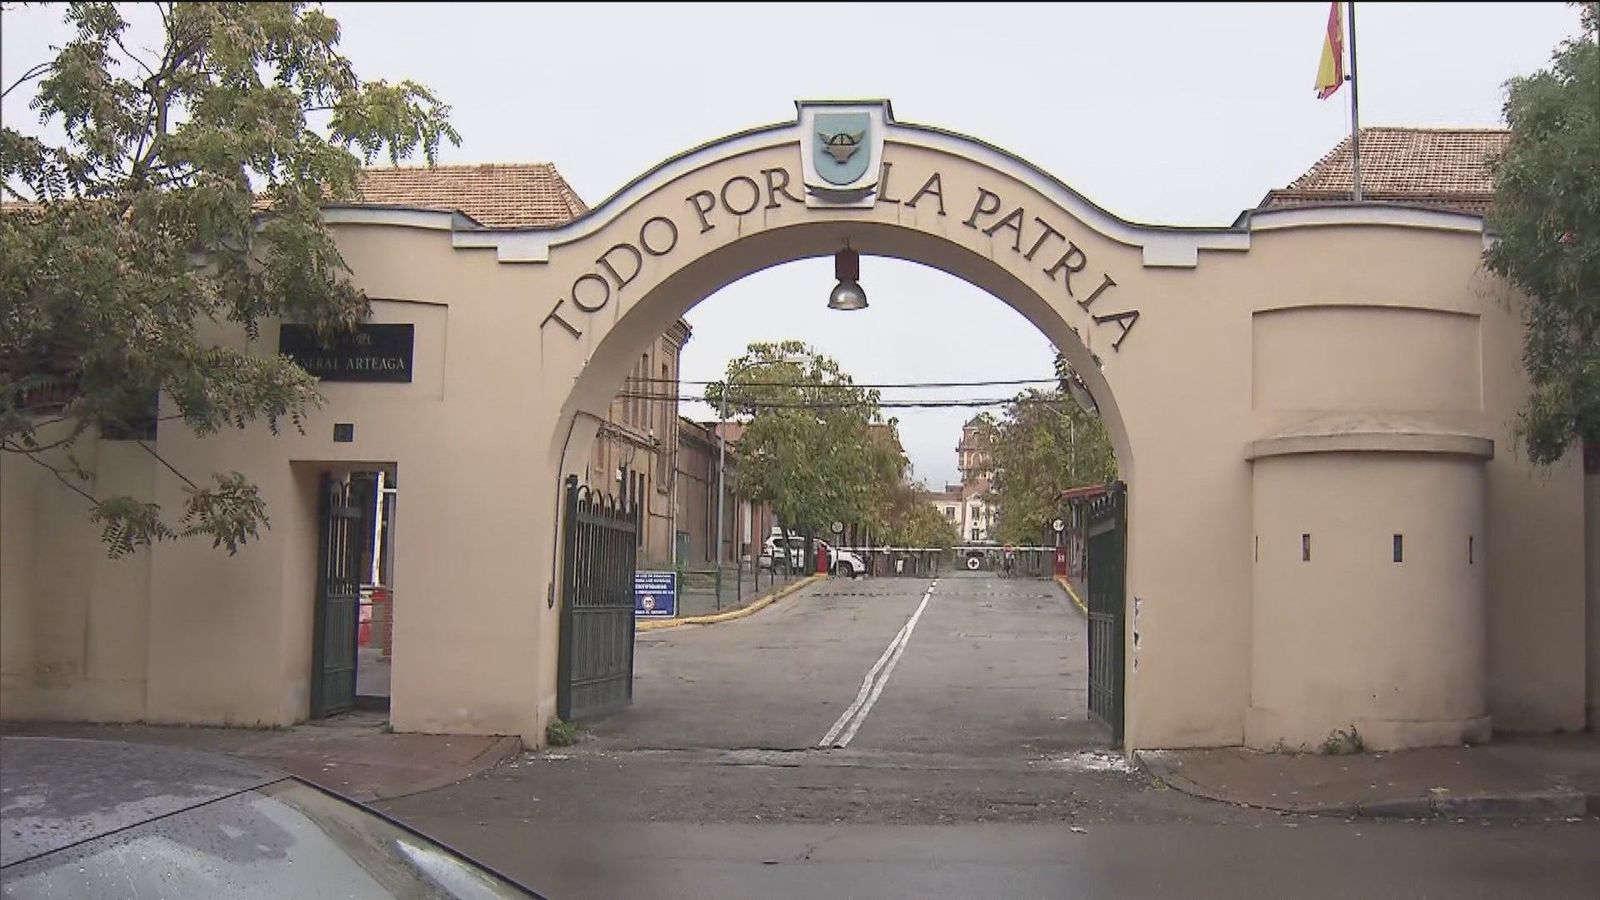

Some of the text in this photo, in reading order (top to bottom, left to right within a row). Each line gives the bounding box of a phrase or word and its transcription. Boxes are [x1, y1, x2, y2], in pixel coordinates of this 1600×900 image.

[540, 161, 1140, 352] TODO POR LA PATRIA
[345, 357, 406, 371] ARTEAGA
